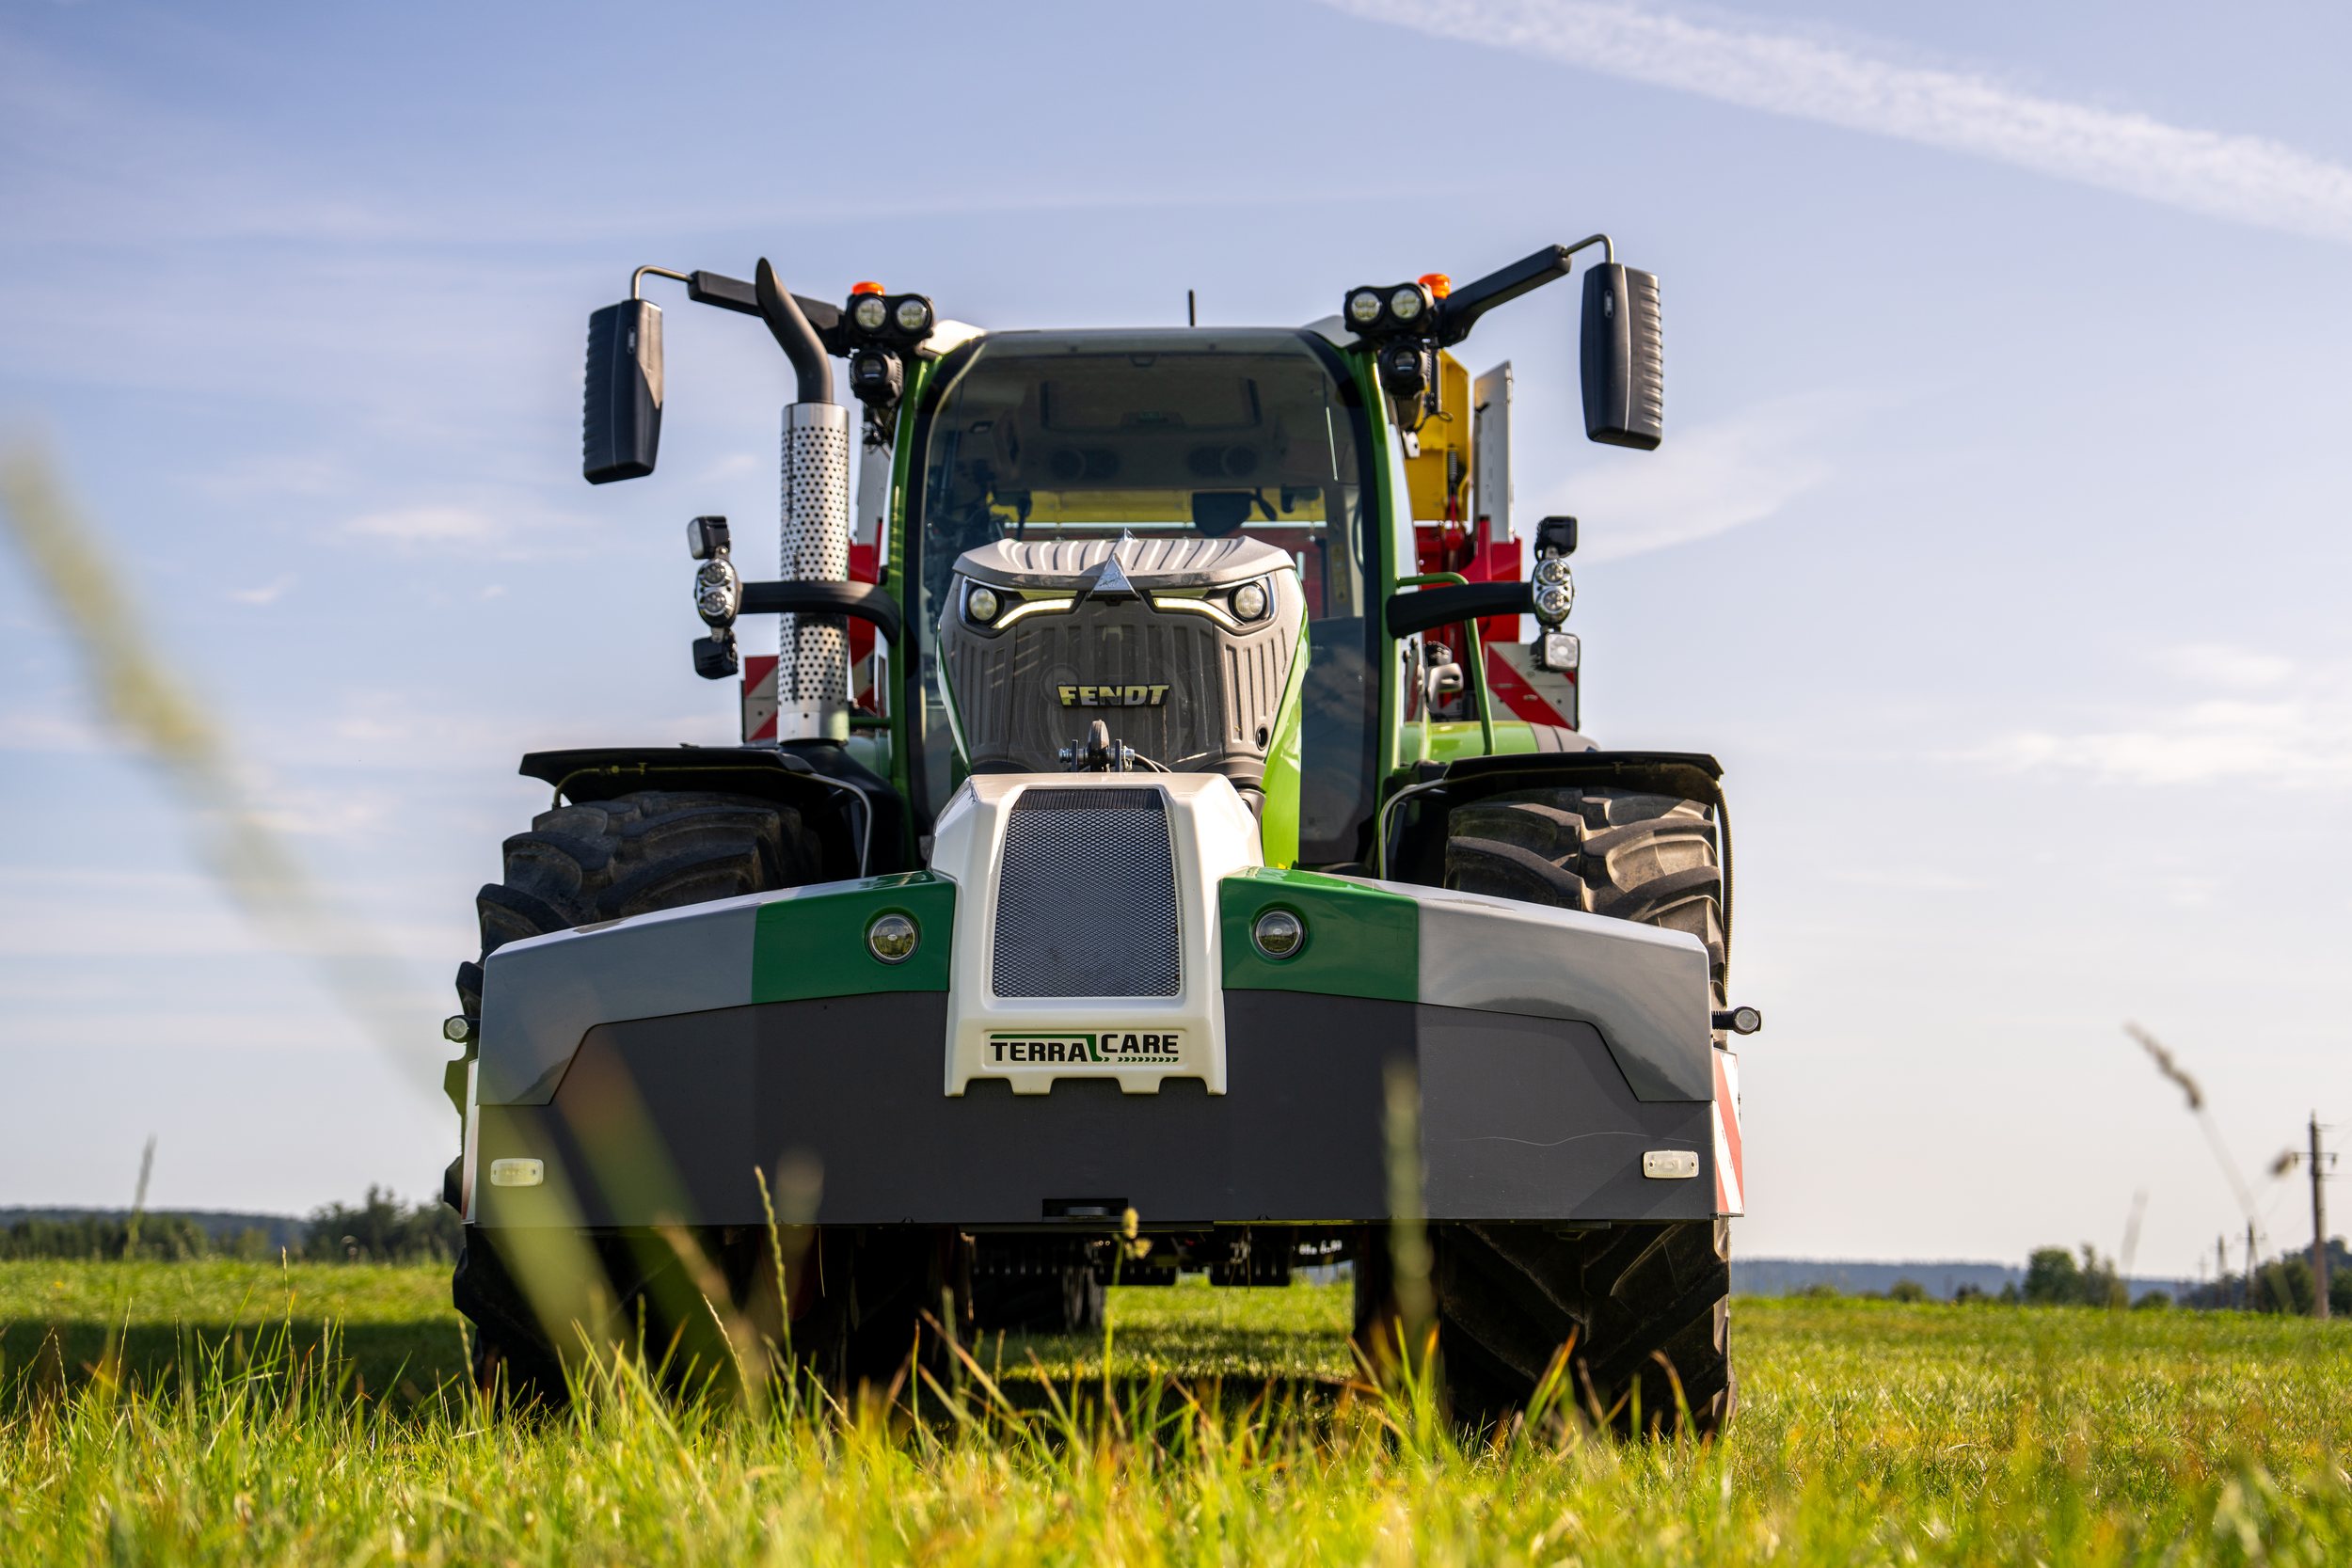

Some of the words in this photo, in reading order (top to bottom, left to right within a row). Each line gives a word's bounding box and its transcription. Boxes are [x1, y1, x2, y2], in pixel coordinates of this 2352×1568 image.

[1058, 685, 1169, 705] FENDT
[991, 1042, 1088, 1062] TERRA
[1101, 1034, 1179, 1053] CARE
